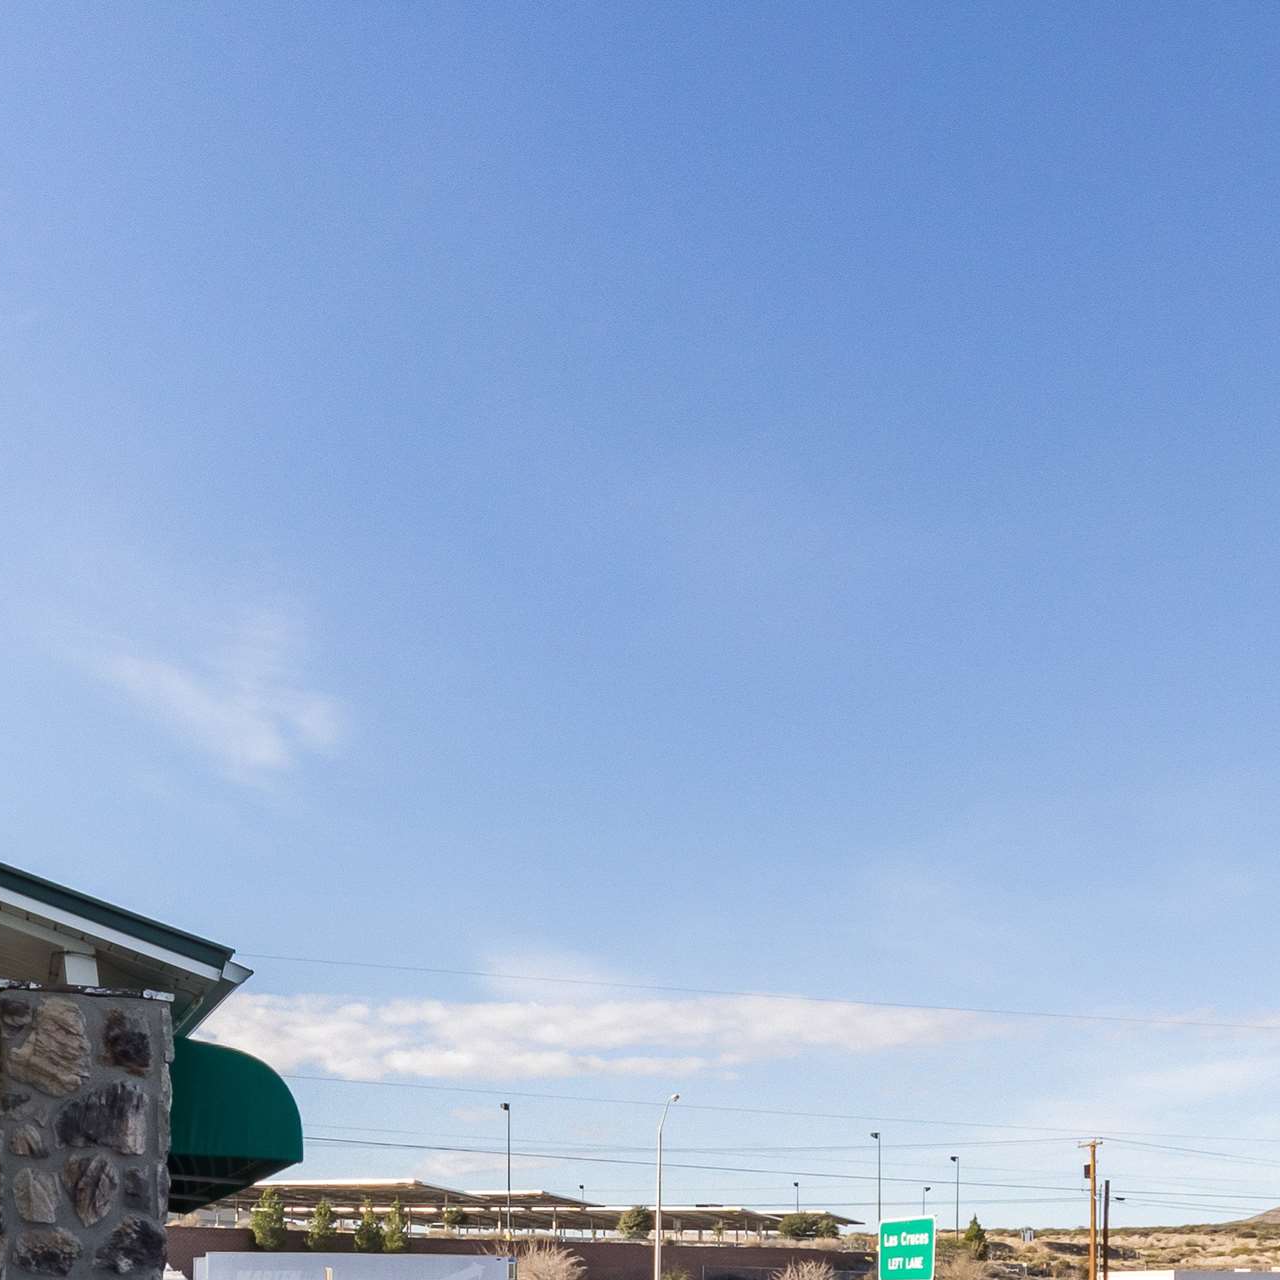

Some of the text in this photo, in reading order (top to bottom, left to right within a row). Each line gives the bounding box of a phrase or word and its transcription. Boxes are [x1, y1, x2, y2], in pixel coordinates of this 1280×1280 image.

[884, 1232, 929, 1247] Las Cruces
[888, 1256, 924, 1270] LEFT LANE
